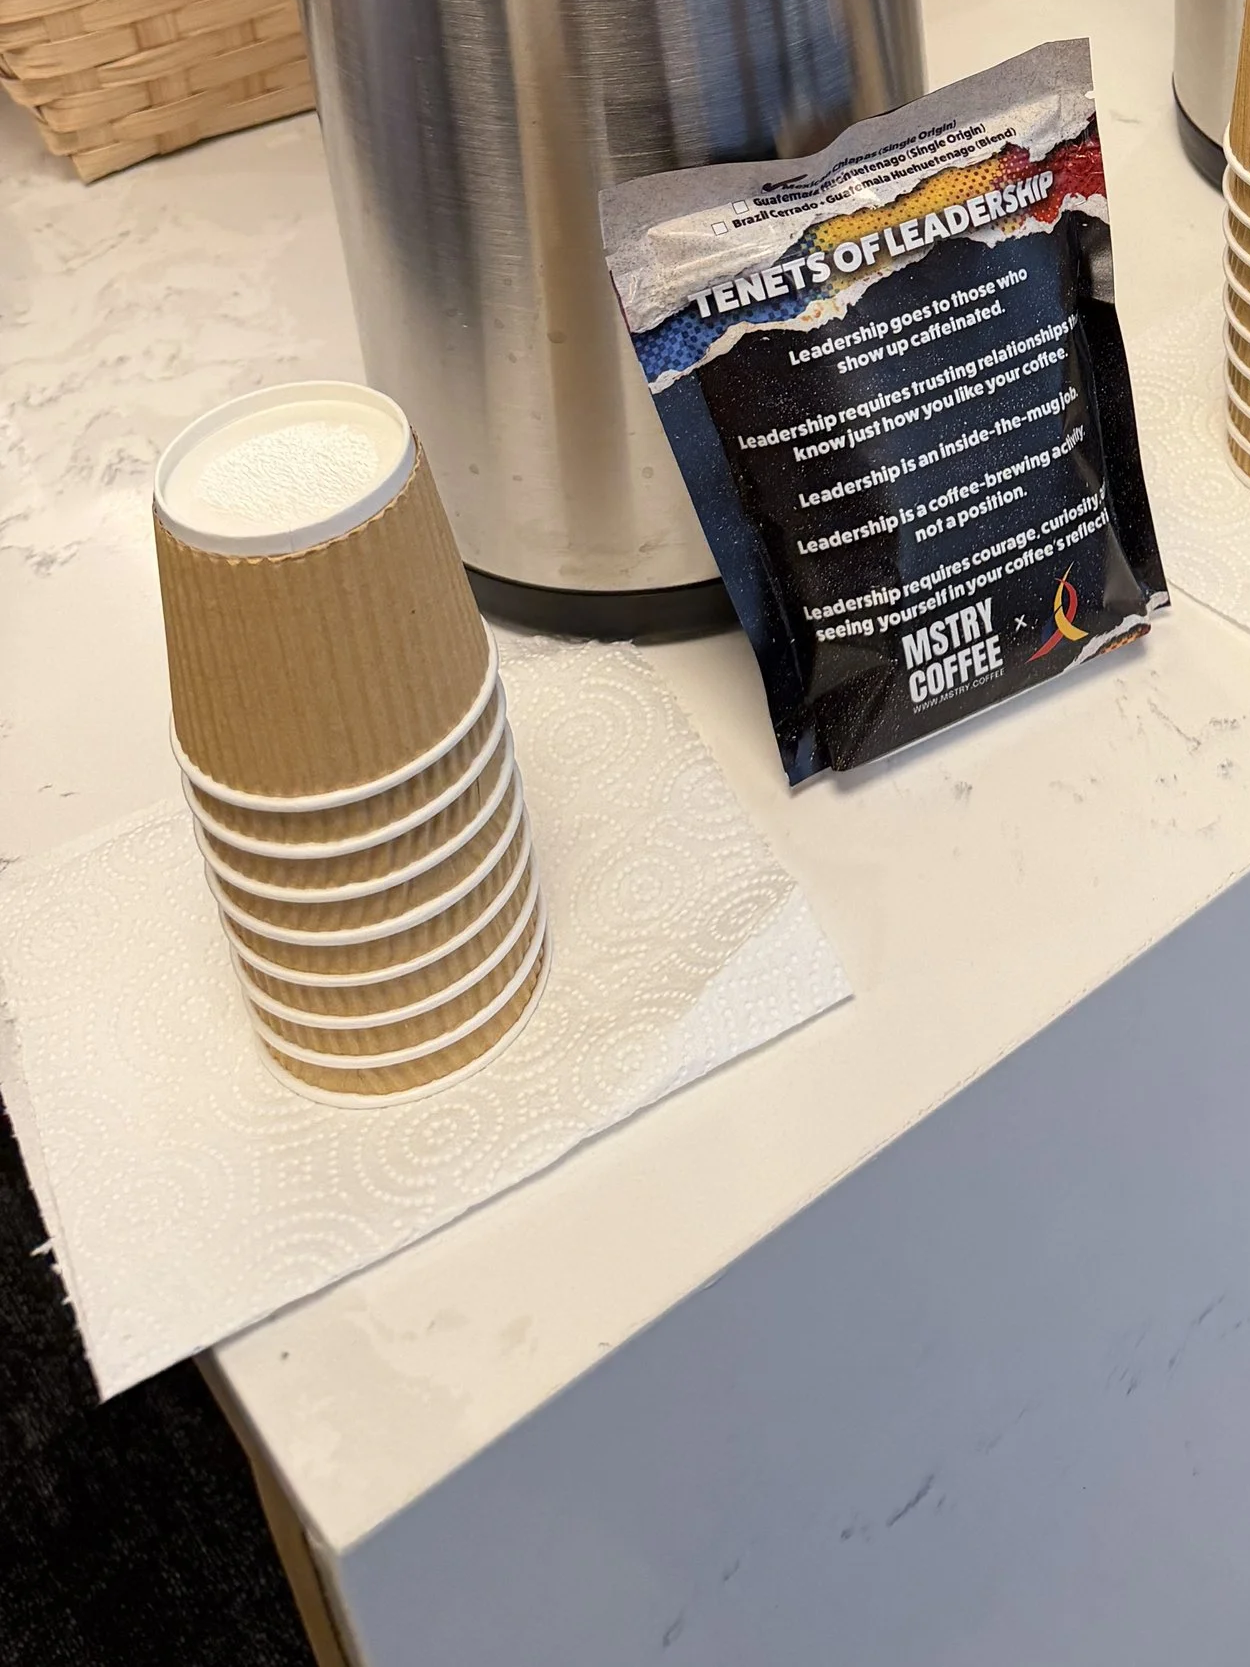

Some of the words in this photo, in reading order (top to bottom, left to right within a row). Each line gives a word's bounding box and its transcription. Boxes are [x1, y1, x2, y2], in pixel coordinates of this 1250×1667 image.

[732, 210, 769, 229] Brazil
[769, 201, 818, 218] Cerrado
[825, 173, 891, 204] Guatemala
[891, 144, 975, 180] Huehuetenago
[975, 127, 1017, 150] (Blend)
[878, 135, 917, 155] (Single
[917, 119, 957, 140] Origin)
[906, 138, 946, 160] (Single
[946, 123, 986, 144] Origin)
[688, 251, 831, 318] TENETS
[833, 232, 881, 274] OF
[883, 170, 1054, 258] LEADERSHIP
[789, 319, 890, 367] Leadership
[889, 307, 933, 335] goes
[932, 297, 951, 316] to
[950, 280, 997, 308] those
[996, 266, 1029, 291] who
[836, 348, 885, 375] show
[886, 338, 910, 359] up
[910, 301, 1007, 349] caffeinated.
[737, 410, 839, 451] Leadership
[838, 385, 912, 426] requires
[911, 361, 979, 397] trusting
[975, 320, 1070, 372] relationships
[793, 432, 846, 463] know
[845, 420, 883, 451] just
[882, 406, 921, 435] how
[920, 394, 955, 422] you
[954, 381, 985, 407] like
[983, 366, 1023, 396] your
[1022, 346, 1069, 378] coffee.
[796, 512, 900, 556] Leadership
[899, 508, 916, 526] is
[915, 505, 929, 519] a
[928, 448, 1052, 513] coffee-brewing
[1051, 423, 1086, 460] activity.
[798, 462, 902, 509] Leadership
[900, 457, 917, 476] is
[917, 449, 940, 468] an
[937, 397, 1063, 461] inside-the-mug
[1060, 385, 1080, 413] job.
[803, 583, 902, 622] Leadership
[901, 560, 971, 599] requires
[970, 528, 1042, 566] courage,
[1040, 492, 1102, 535] curiosity,
[914, 520, 945, 544] not
[945, 516, 957, 530] a
[956, 484, 1028, 528] position.
[815, 618, 874, 643] seeing
[879, 591, 950, 634] yourself
[948, 583, 966, 602] in
[965, 563, 1004, 592] your
[1003, 536, 1065, 576] coffee's
[1065, 506, 1110, 548] reflecti
[901, 597, 995, 670] MSTRY
[908, 634, 1004, 704] COFFEE
[912, 668, 1006, 715] WWW.MSTRY.COFFEE
